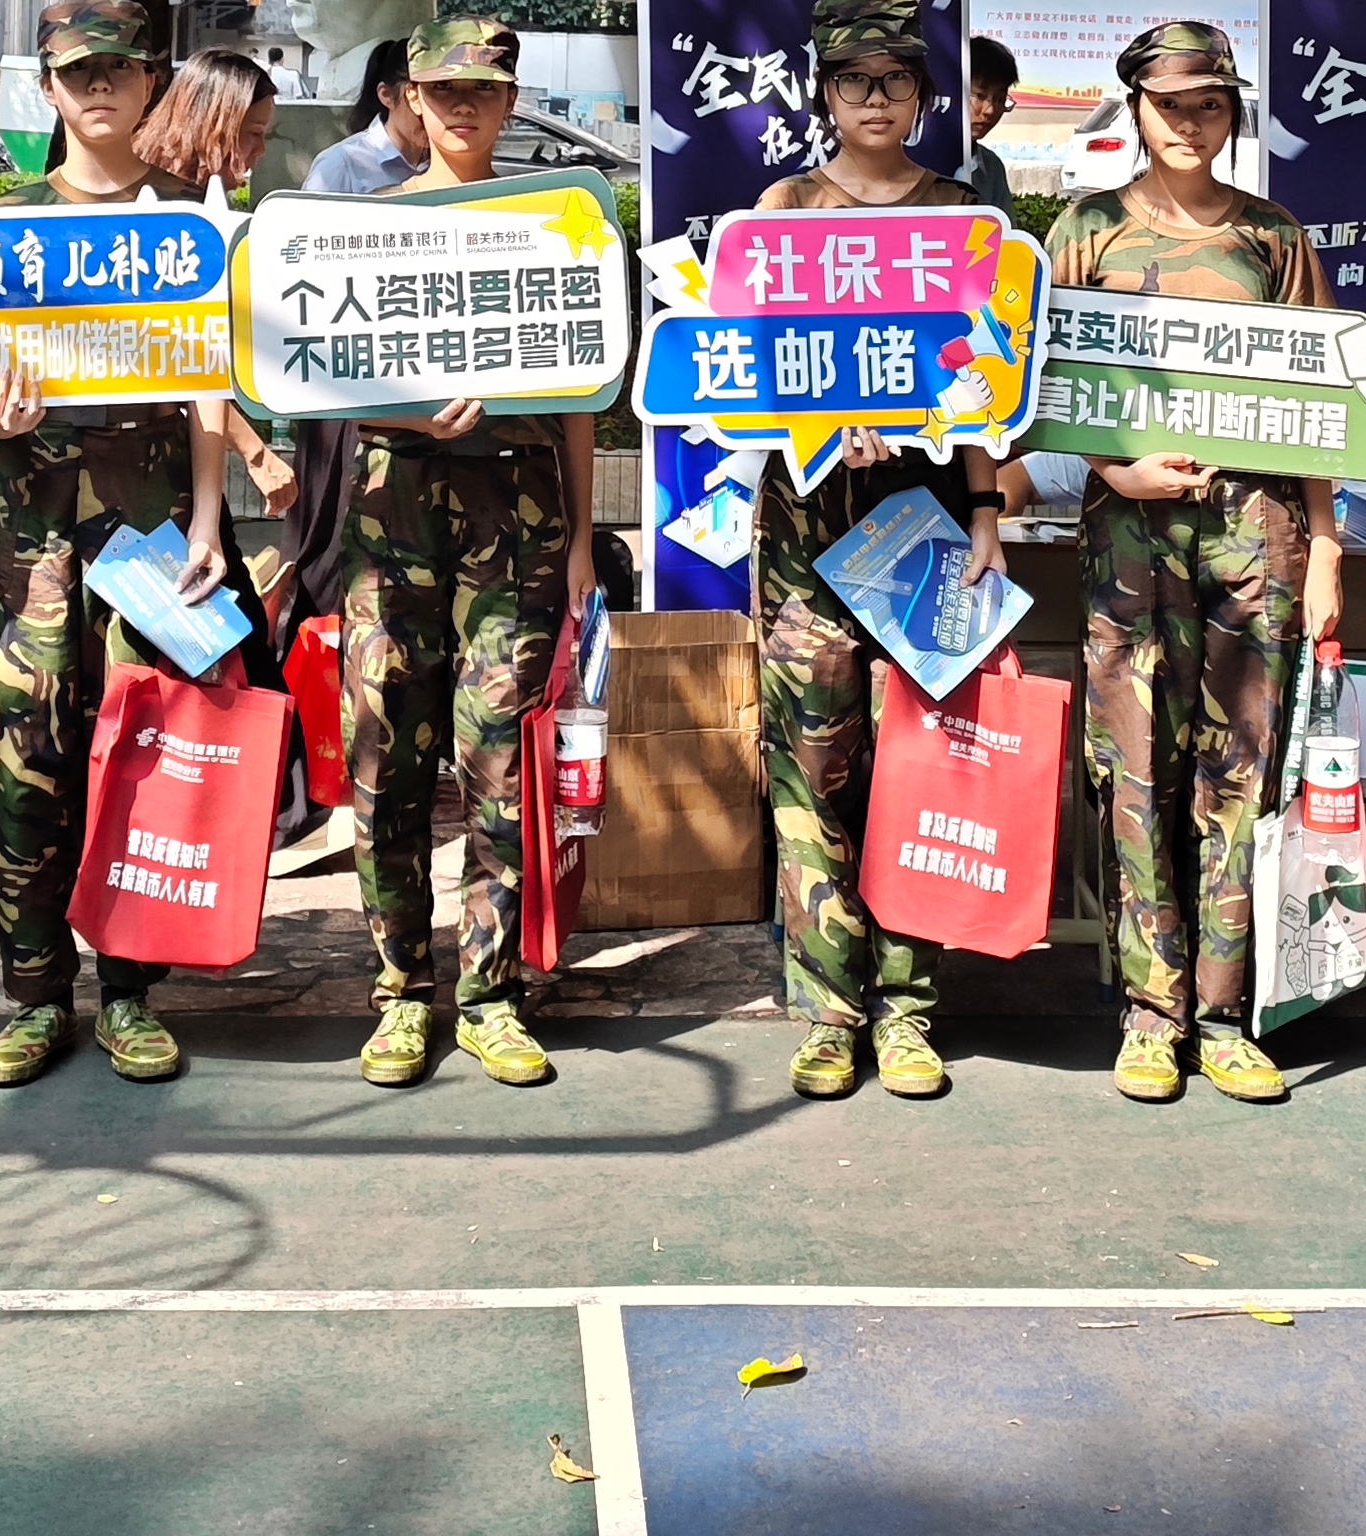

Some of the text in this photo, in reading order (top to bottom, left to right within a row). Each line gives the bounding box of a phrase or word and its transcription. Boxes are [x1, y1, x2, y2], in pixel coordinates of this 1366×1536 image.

[672, 33, 818, 118] “全民
[314, 229, 531, 252] 中国邮政储蓄银行 韶关市分行
[315, 252, 345, 262] POSTAL
[348, 251, 383, 261] SAVINGS
[385, 250, 407, 260] BANK
[409, 249, 420, 258] OF
[423, 248, 449, 258] CHINA
[744, 231, 953, 305] 社保卡
[281, 265, 602, 326] 个人资料要保密
[283, 319, 605, 383] 不明来电多警惕
[692, 325, 916, 402] 选邮储
[1046, 307, 1327, 374] 买卖账户必严惩
[1036, 375, 1348, 451] 莫让小利断前程
